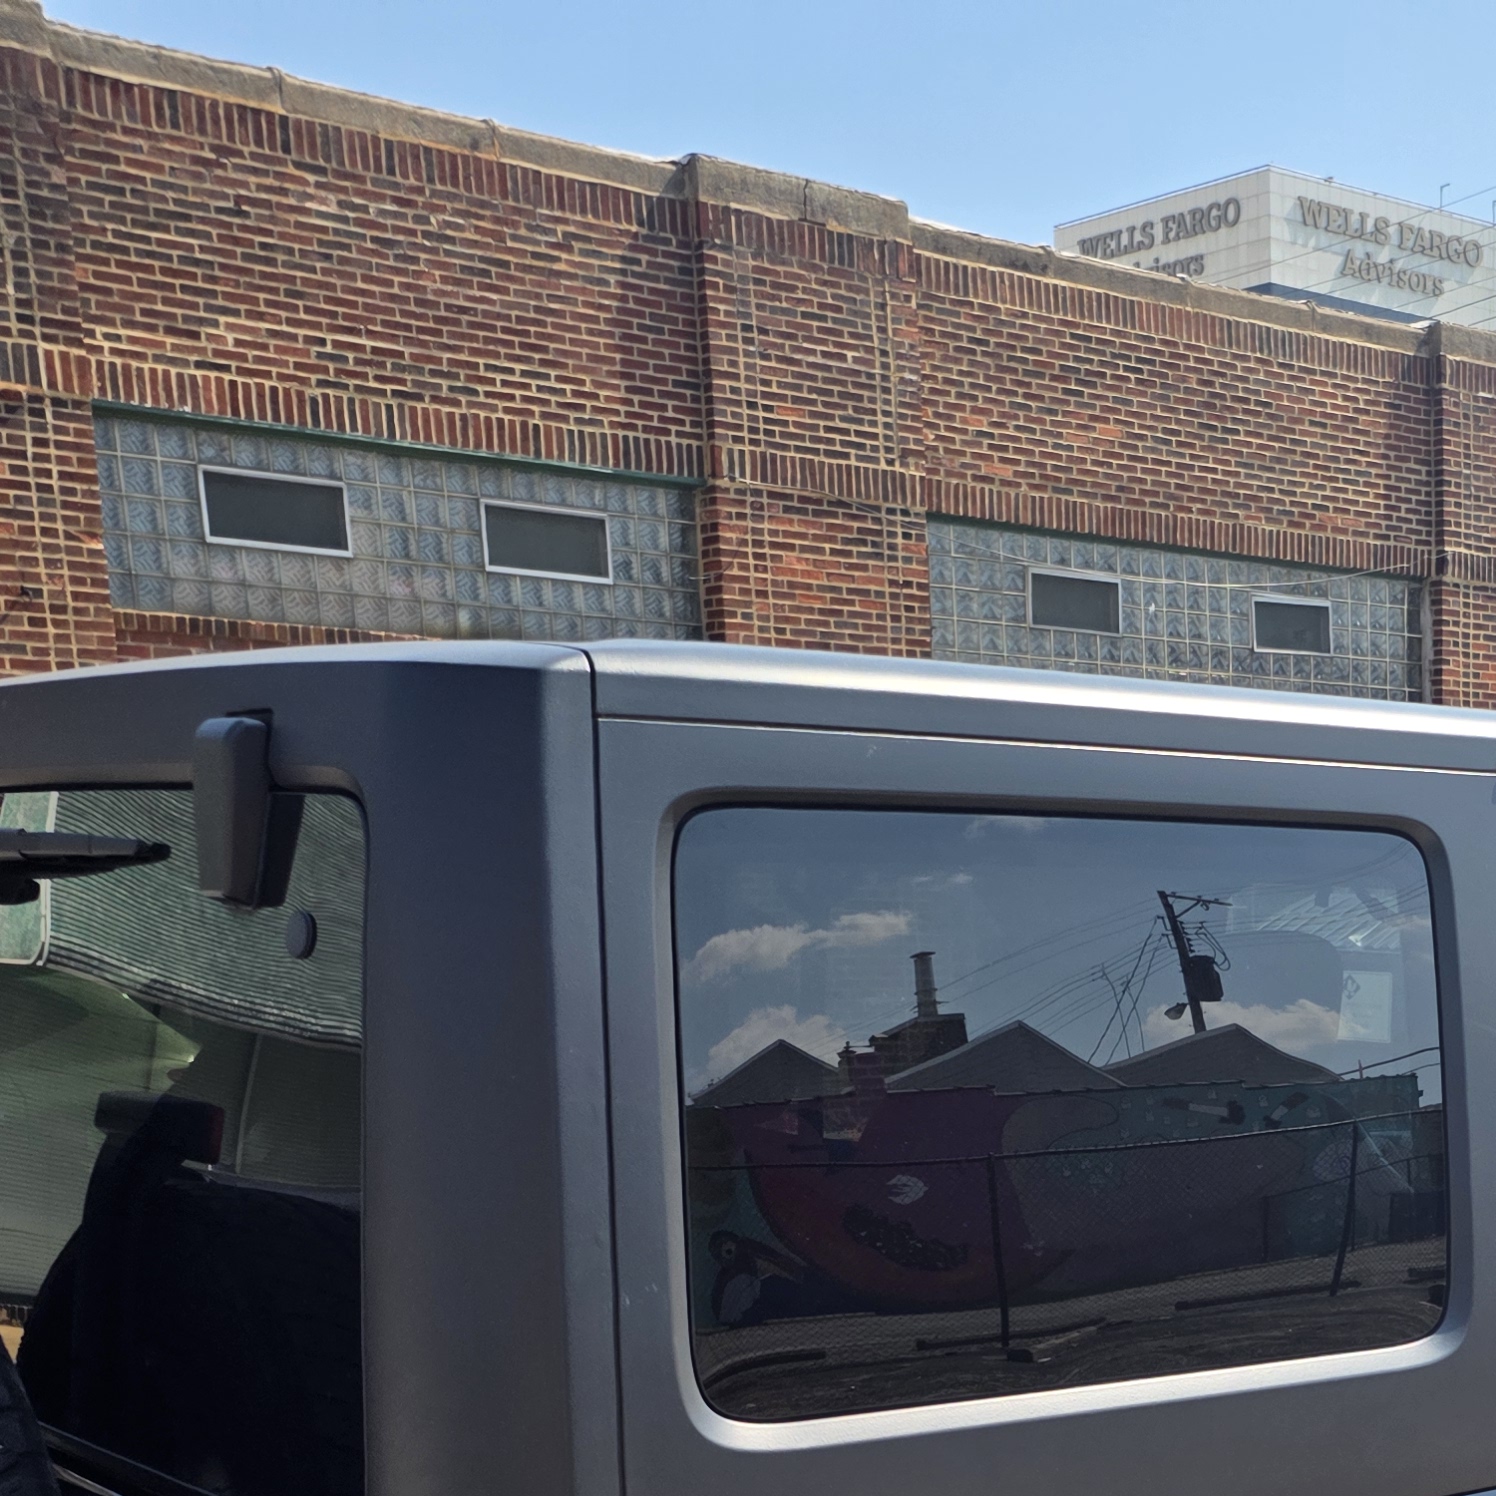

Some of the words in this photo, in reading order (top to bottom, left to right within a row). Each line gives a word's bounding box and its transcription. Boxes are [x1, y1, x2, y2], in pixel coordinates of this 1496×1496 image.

[1077, 221, 1155, 260] WELLS
[1160, 197, 1241, 246] FARGO
[1298, 196, 1392, 246] WELLS
[1399, 222, 1485, 269] FARGO
[1132, 254, 1204, 278] isors
[1341, 248, 1446, 297] Advisors
